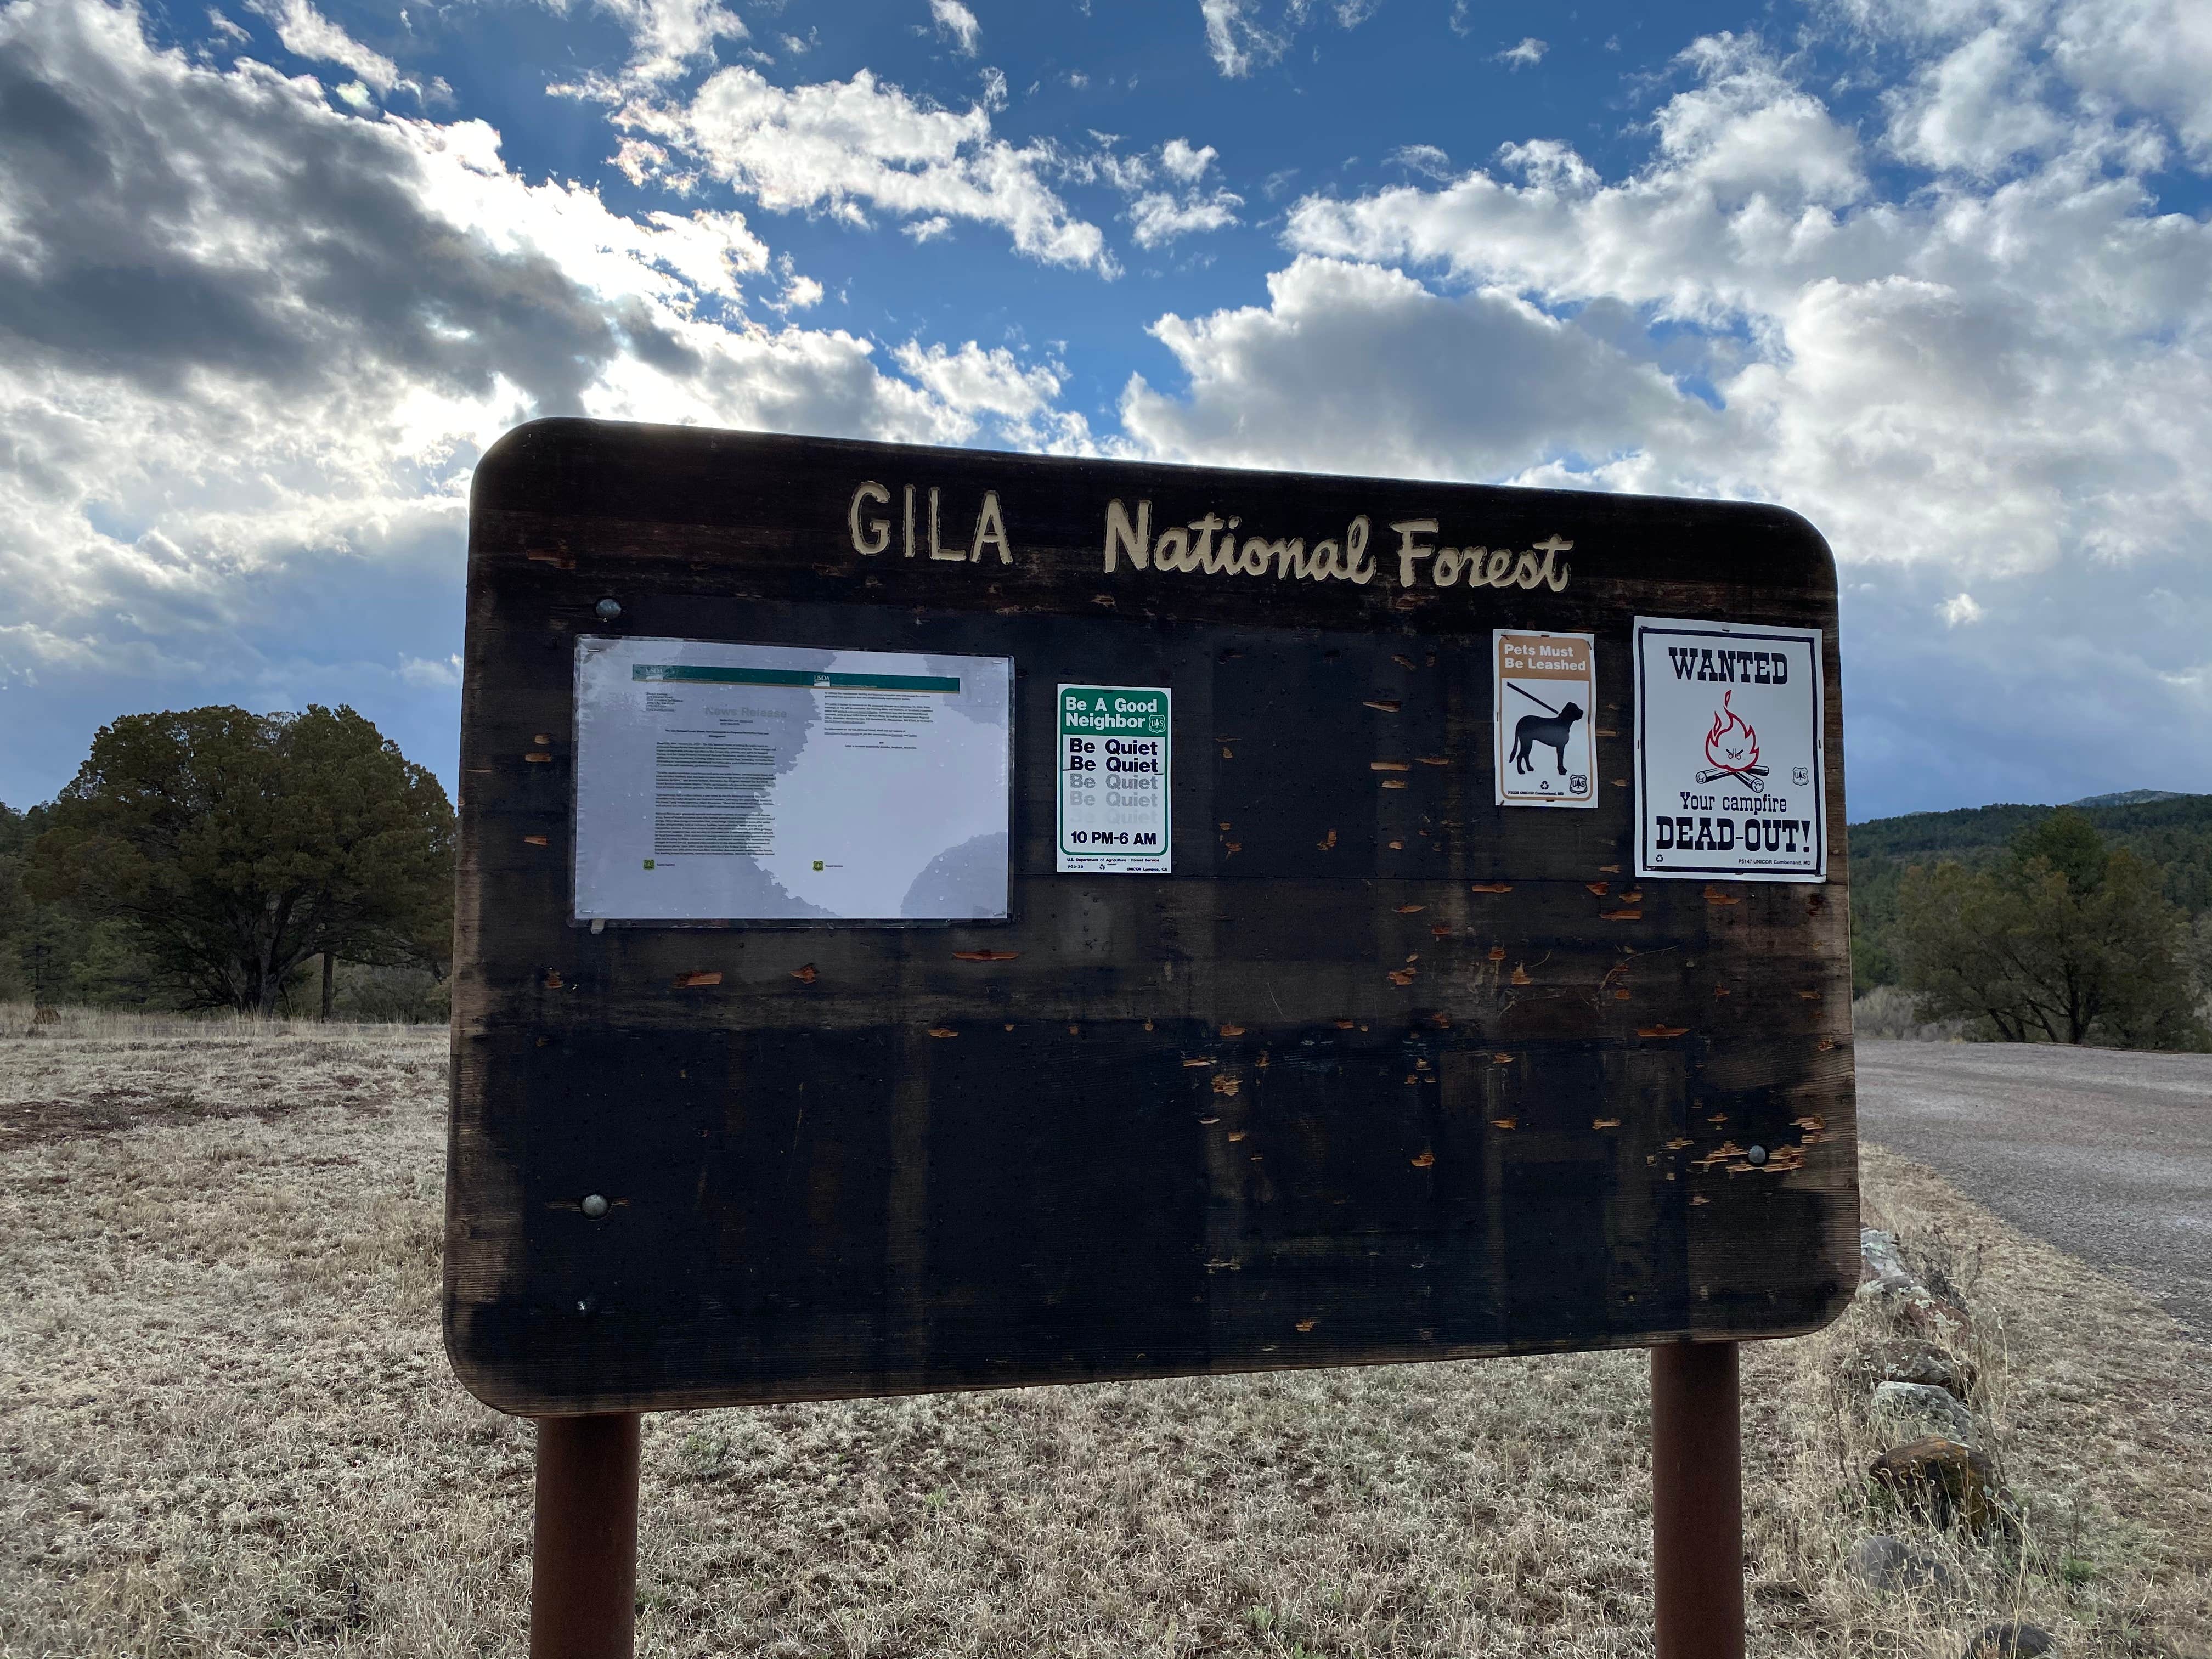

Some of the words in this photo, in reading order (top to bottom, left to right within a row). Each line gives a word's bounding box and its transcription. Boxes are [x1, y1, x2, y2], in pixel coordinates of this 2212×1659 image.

[847, 480, 1014, 565] GILA
[1103, 498, 1376, 585] National
[1390, 517, 1575, 593] Forest
[1504, 644, 1536, 656] Pets
[1539, 645, 1573, 657] Must
[1505, 658, 1523, 669] Be
[1528, 658, 1586, 672] Leashed
[1668, 646, 1788, 685] WANTED
[706, 706, 737, 716] News
[741, 707, 787, 718] Release
[1065, 696, 1087, 711] Be
[1094, 697, 1107, 712] A
[1114, 698, 1158, 713] Good
[1065, 713, 1146, 730] Neighbor
[1070, 738, 1096, 754] Be
[1105, 739, 1158, 755] Quiet
[1070, 755, 1096, 771] Be
[1105, 757, 1158, 773] Quiet
[1070, 773, 1096, 788] Be
[1105, 774, 1158, 790] Quiet
[1070, 791, 1096, 806] Be
[1105, 791, 1158, 807] Quiet
[1680, 792, 1715, 811] Your
[1723, 794, 1787, 815] campfire
[1105, 809, 1158, 825] Quiet
[1070, 831, 1087, 844] 10
[1091, 831, 1129, 845] PM-6
[1133, 832, 1156, 845] AM
[1656, 816, 1811, 853] DEAD-OUT!
